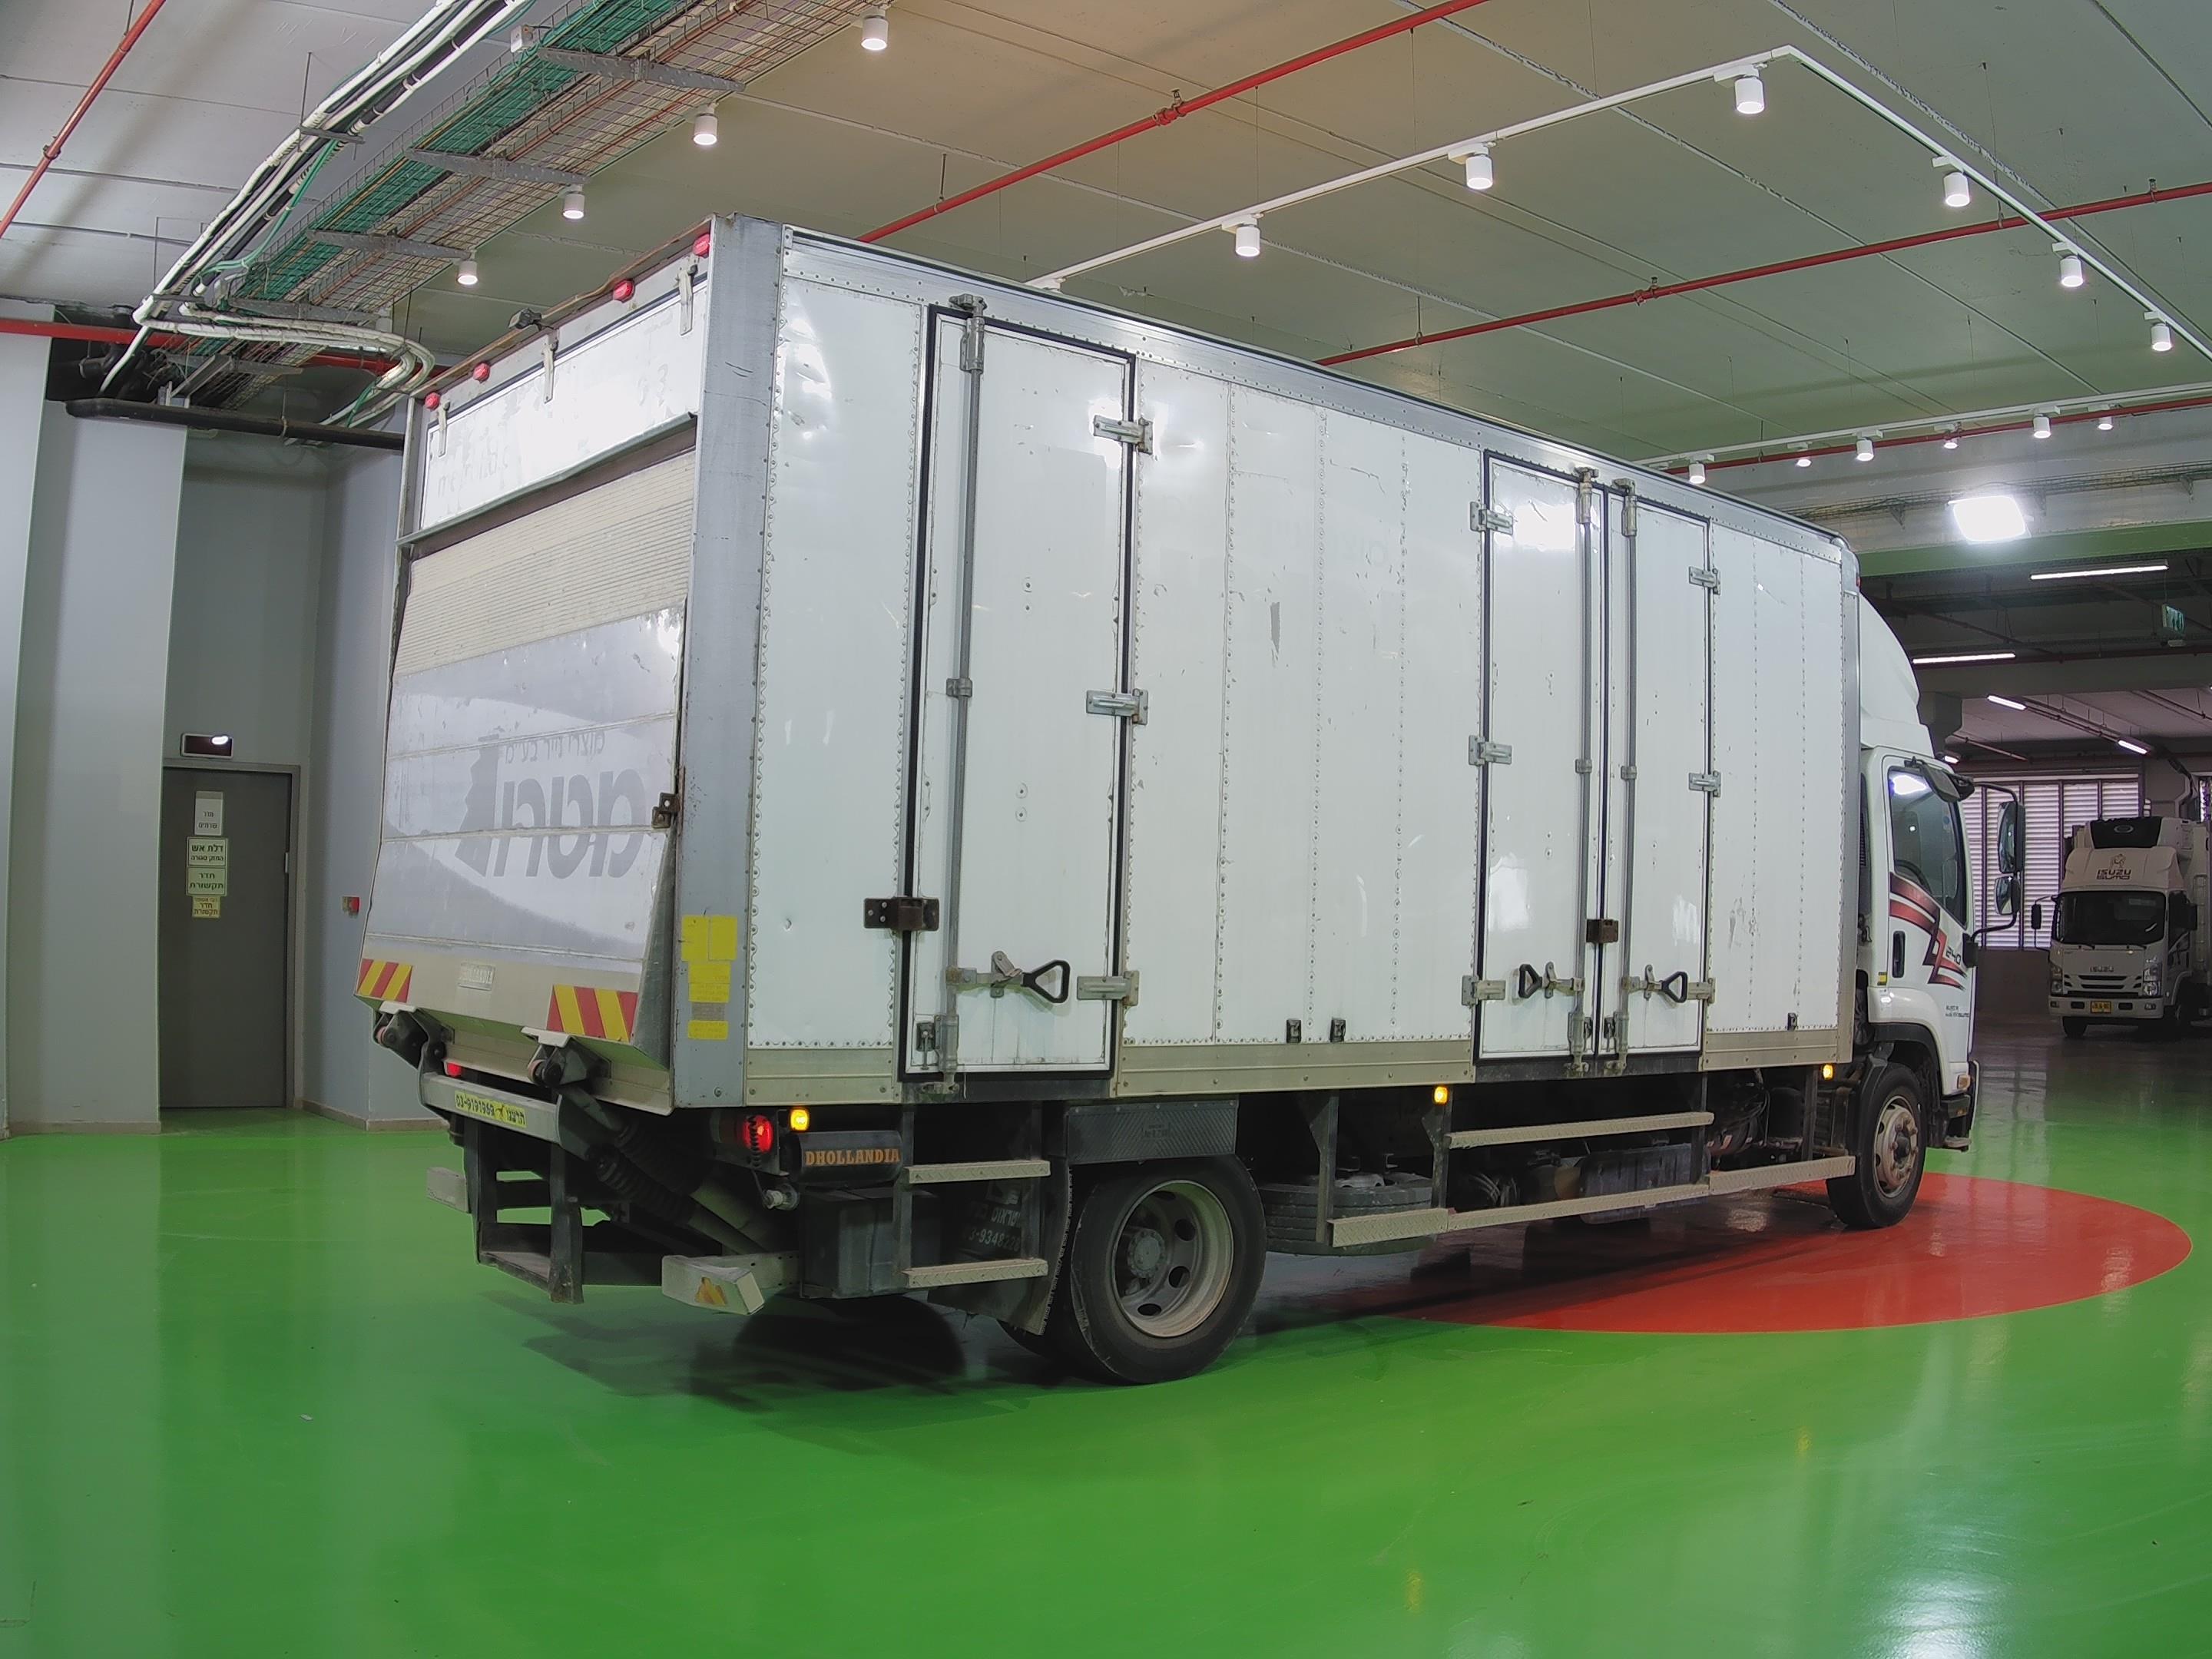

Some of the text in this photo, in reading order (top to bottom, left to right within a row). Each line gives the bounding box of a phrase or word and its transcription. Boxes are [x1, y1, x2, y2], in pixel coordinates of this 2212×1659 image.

[544, 736, 564, 760] נייר
[208, 844, 224, 853] דלת
[190, 882, 224, 890] תקשורת
[806, 1149, 900, 1165] DHOLLANDIA
